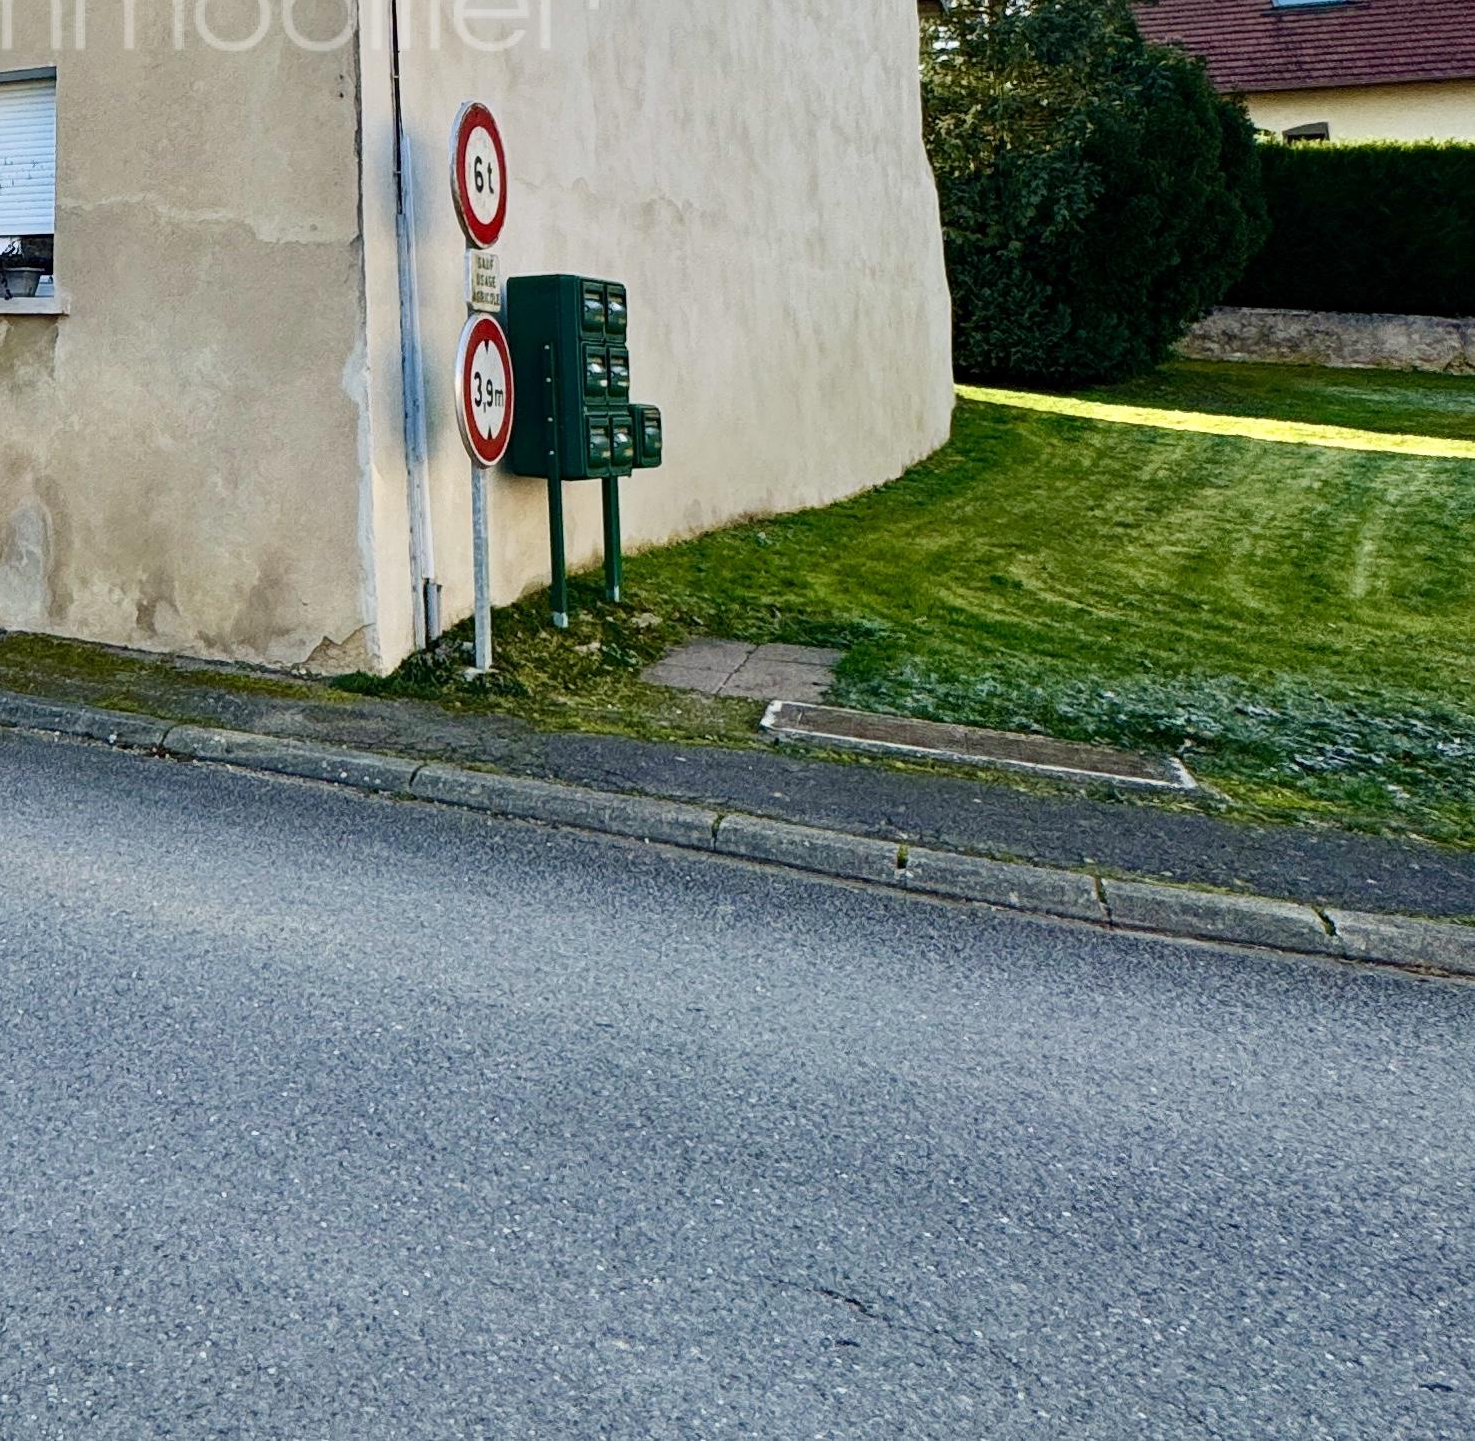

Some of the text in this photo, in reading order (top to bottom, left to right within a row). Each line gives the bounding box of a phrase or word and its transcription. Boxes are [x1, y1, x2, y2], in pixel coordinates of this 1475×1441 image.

[477, 256, 494, 270] SAUF
[476, 273, 496, 288] USAGE
[472, 290, 500, 306] AGRICOLE
